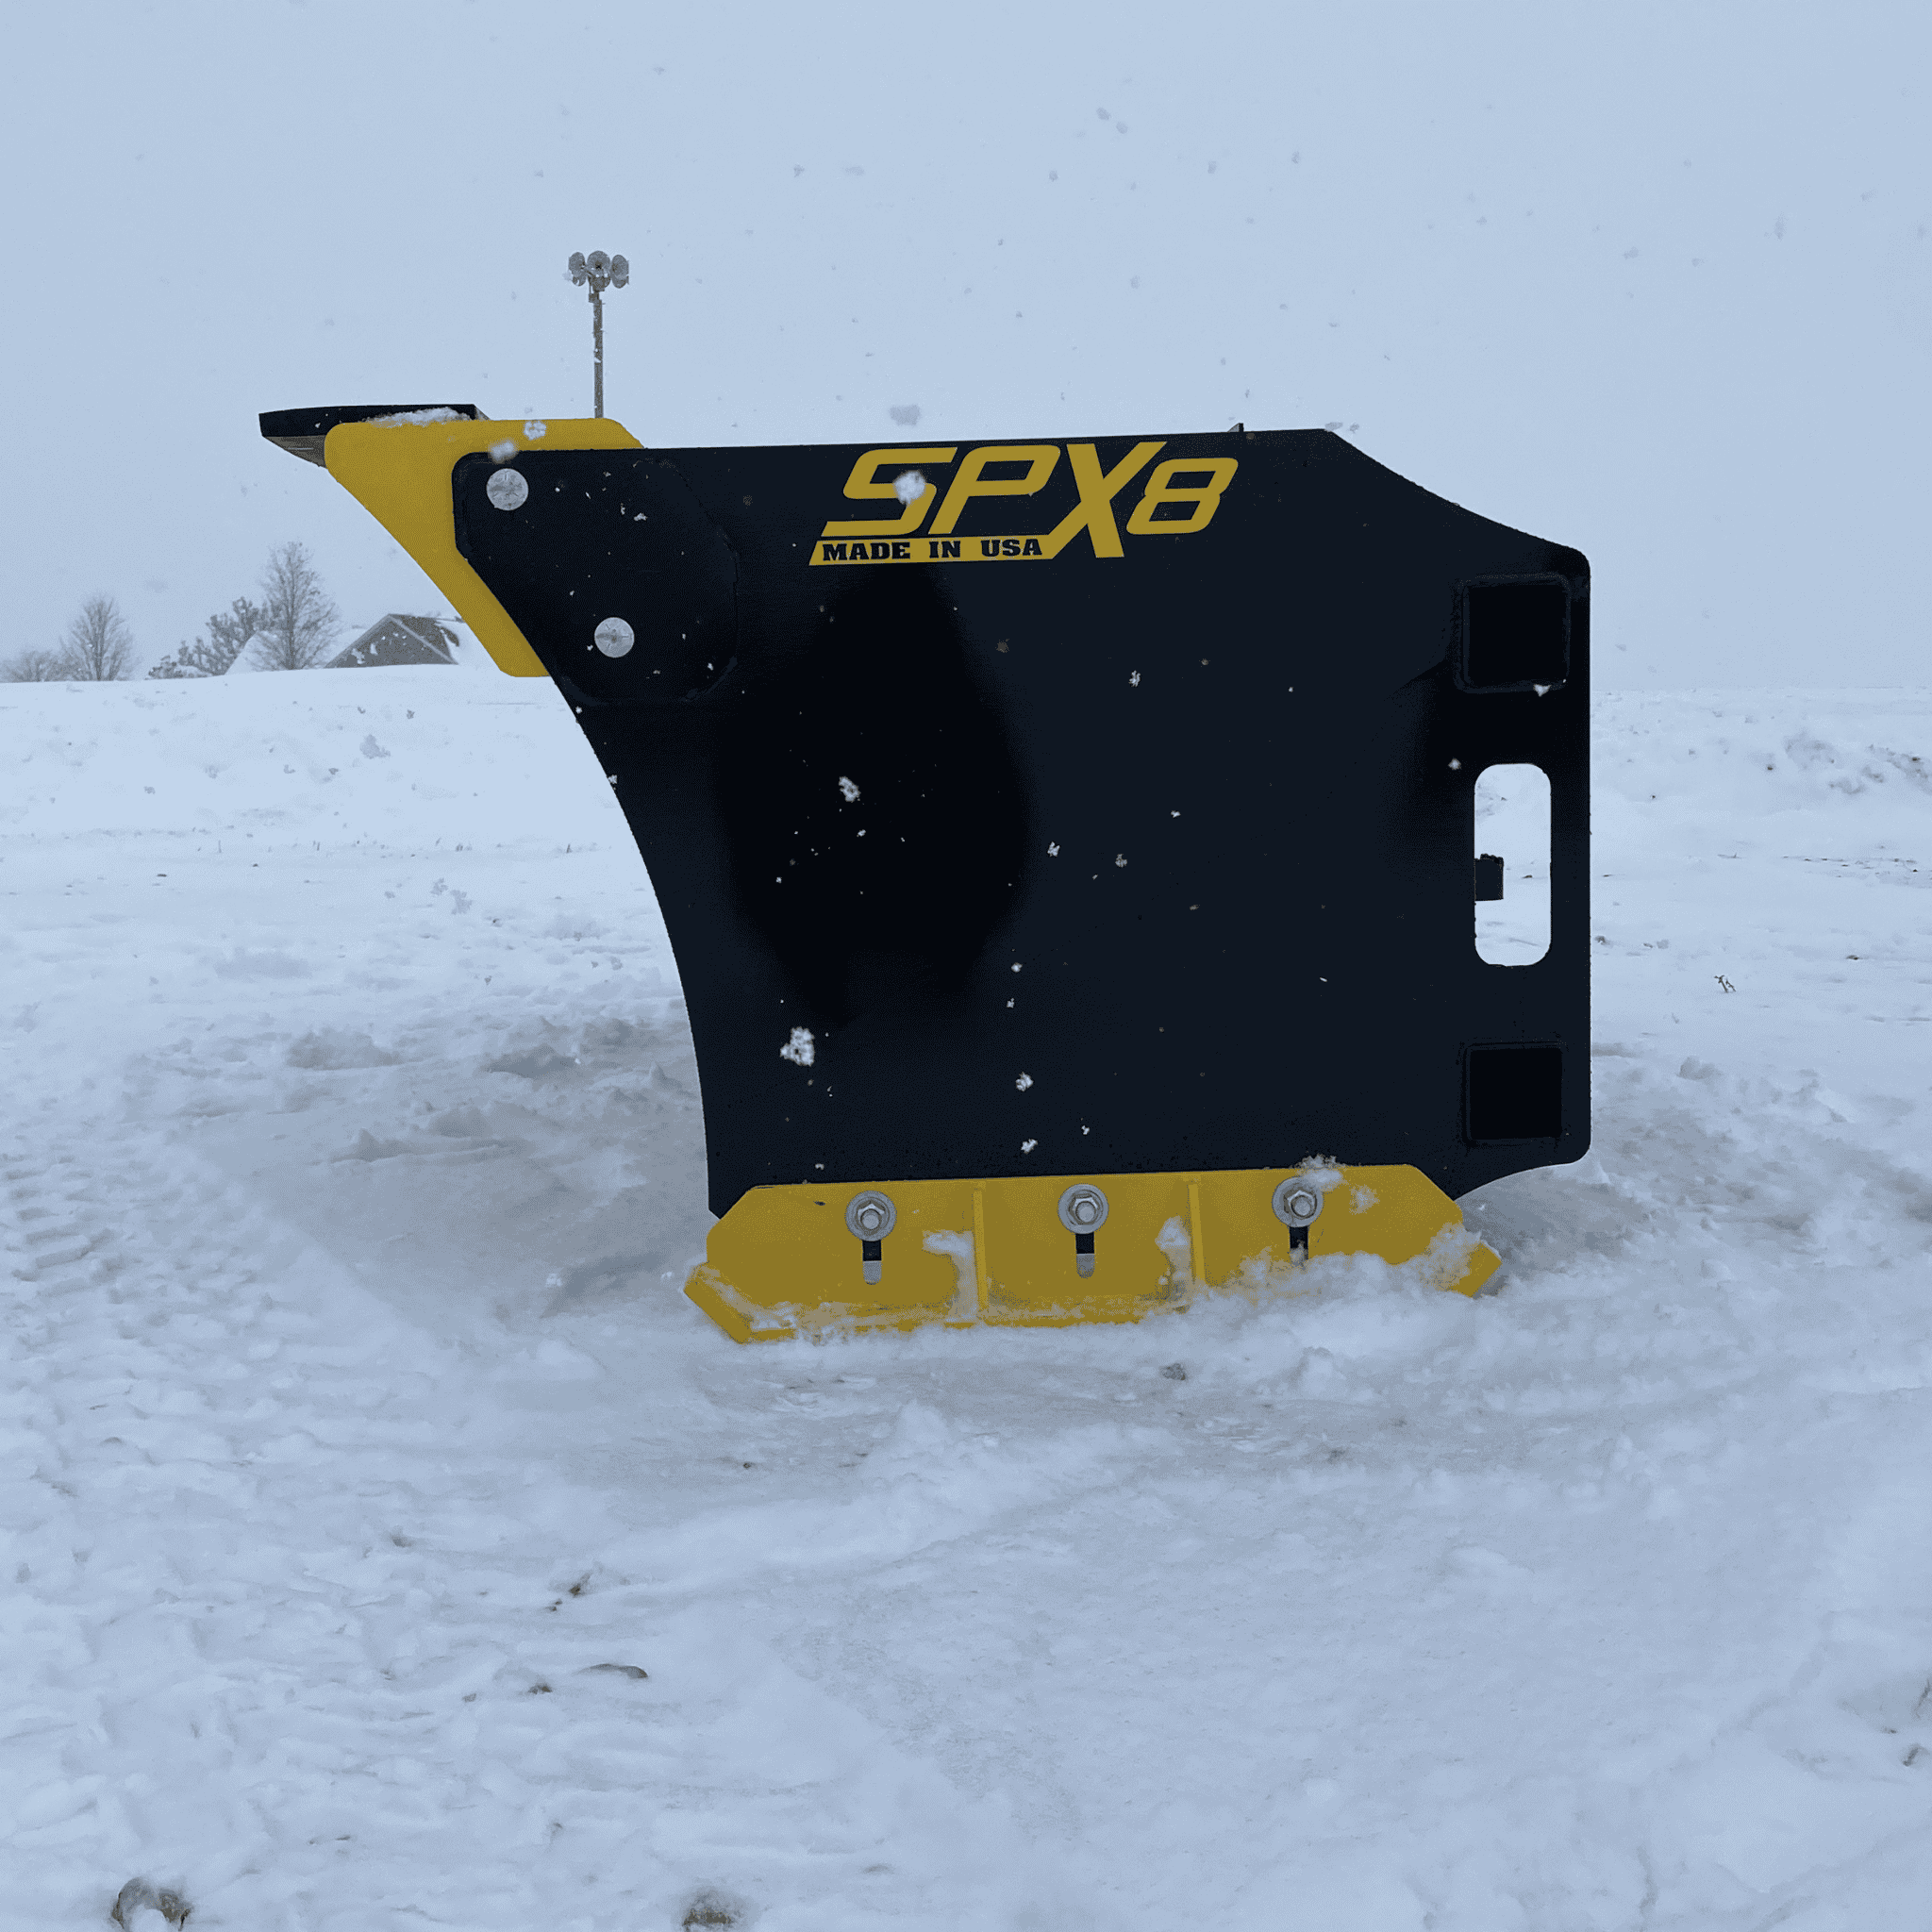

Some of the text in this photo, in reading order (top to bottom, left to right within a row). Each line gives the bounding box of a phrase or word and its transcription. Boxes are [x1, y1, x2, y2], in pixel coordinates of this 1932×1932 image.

[821, 441, 1239, 558] SPX8
[823, 539, 1042, 561] MADE IN USA
